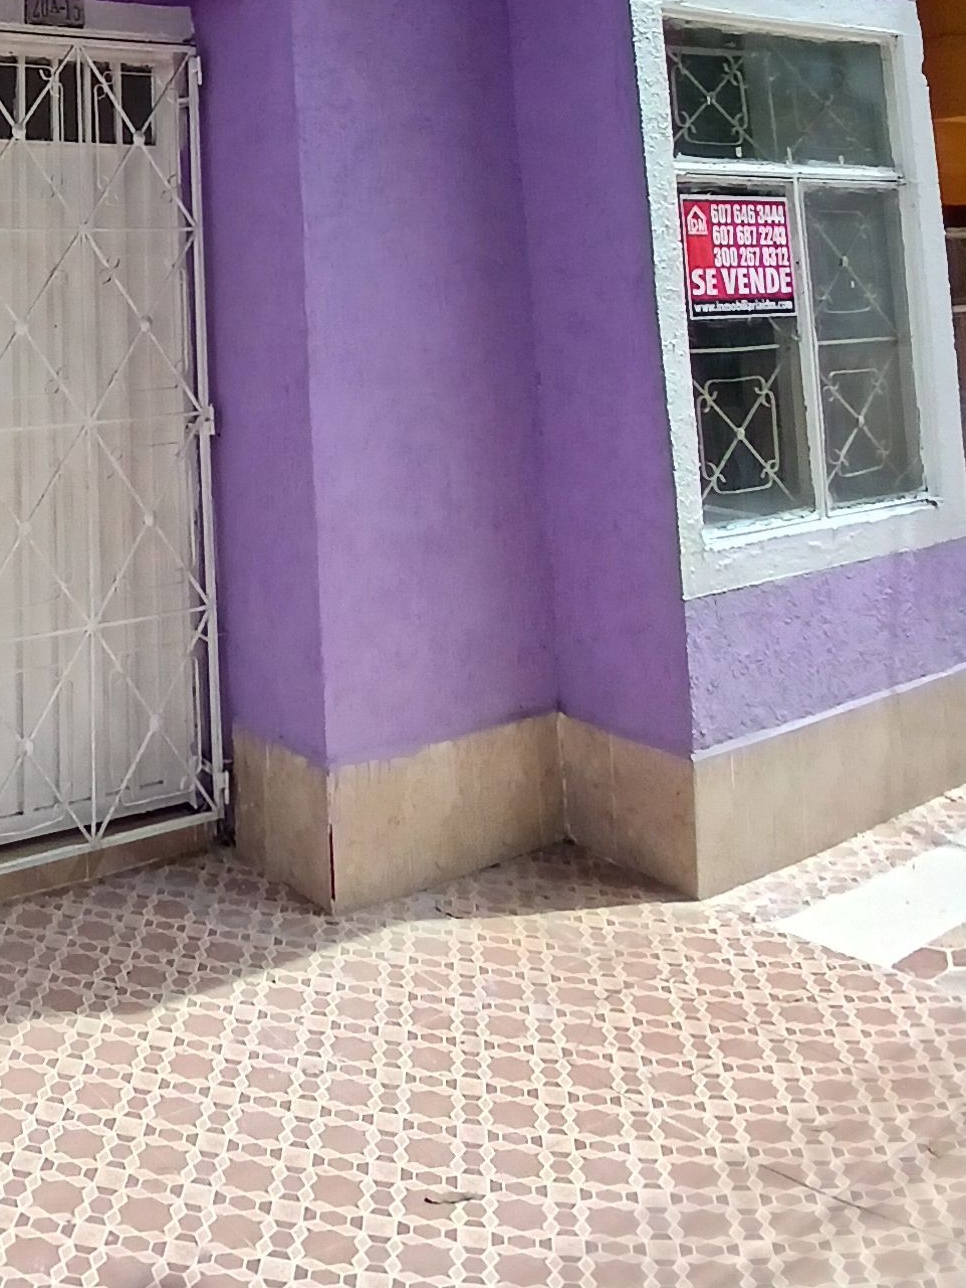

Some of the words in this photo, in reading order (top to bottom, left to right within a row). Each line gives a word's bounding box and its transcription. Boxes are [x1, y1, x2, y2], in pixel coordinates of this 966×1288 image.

[710, 204, 732, 224] 607
[733, 204, 755, 224] 646
[756, 205, 784, 224] 3444
[712, 225, 733, 245] 607
[736, 225, 757, 245] 687
[759, 225, 787, 245] 2243
[714, 247, 738, 267] 300
[739, 247, 760, 267] 267
[762, 247, 789, 266] 8312
[691, 268, 719, 296] SE
[720, 267, 792, 295] VENDE
